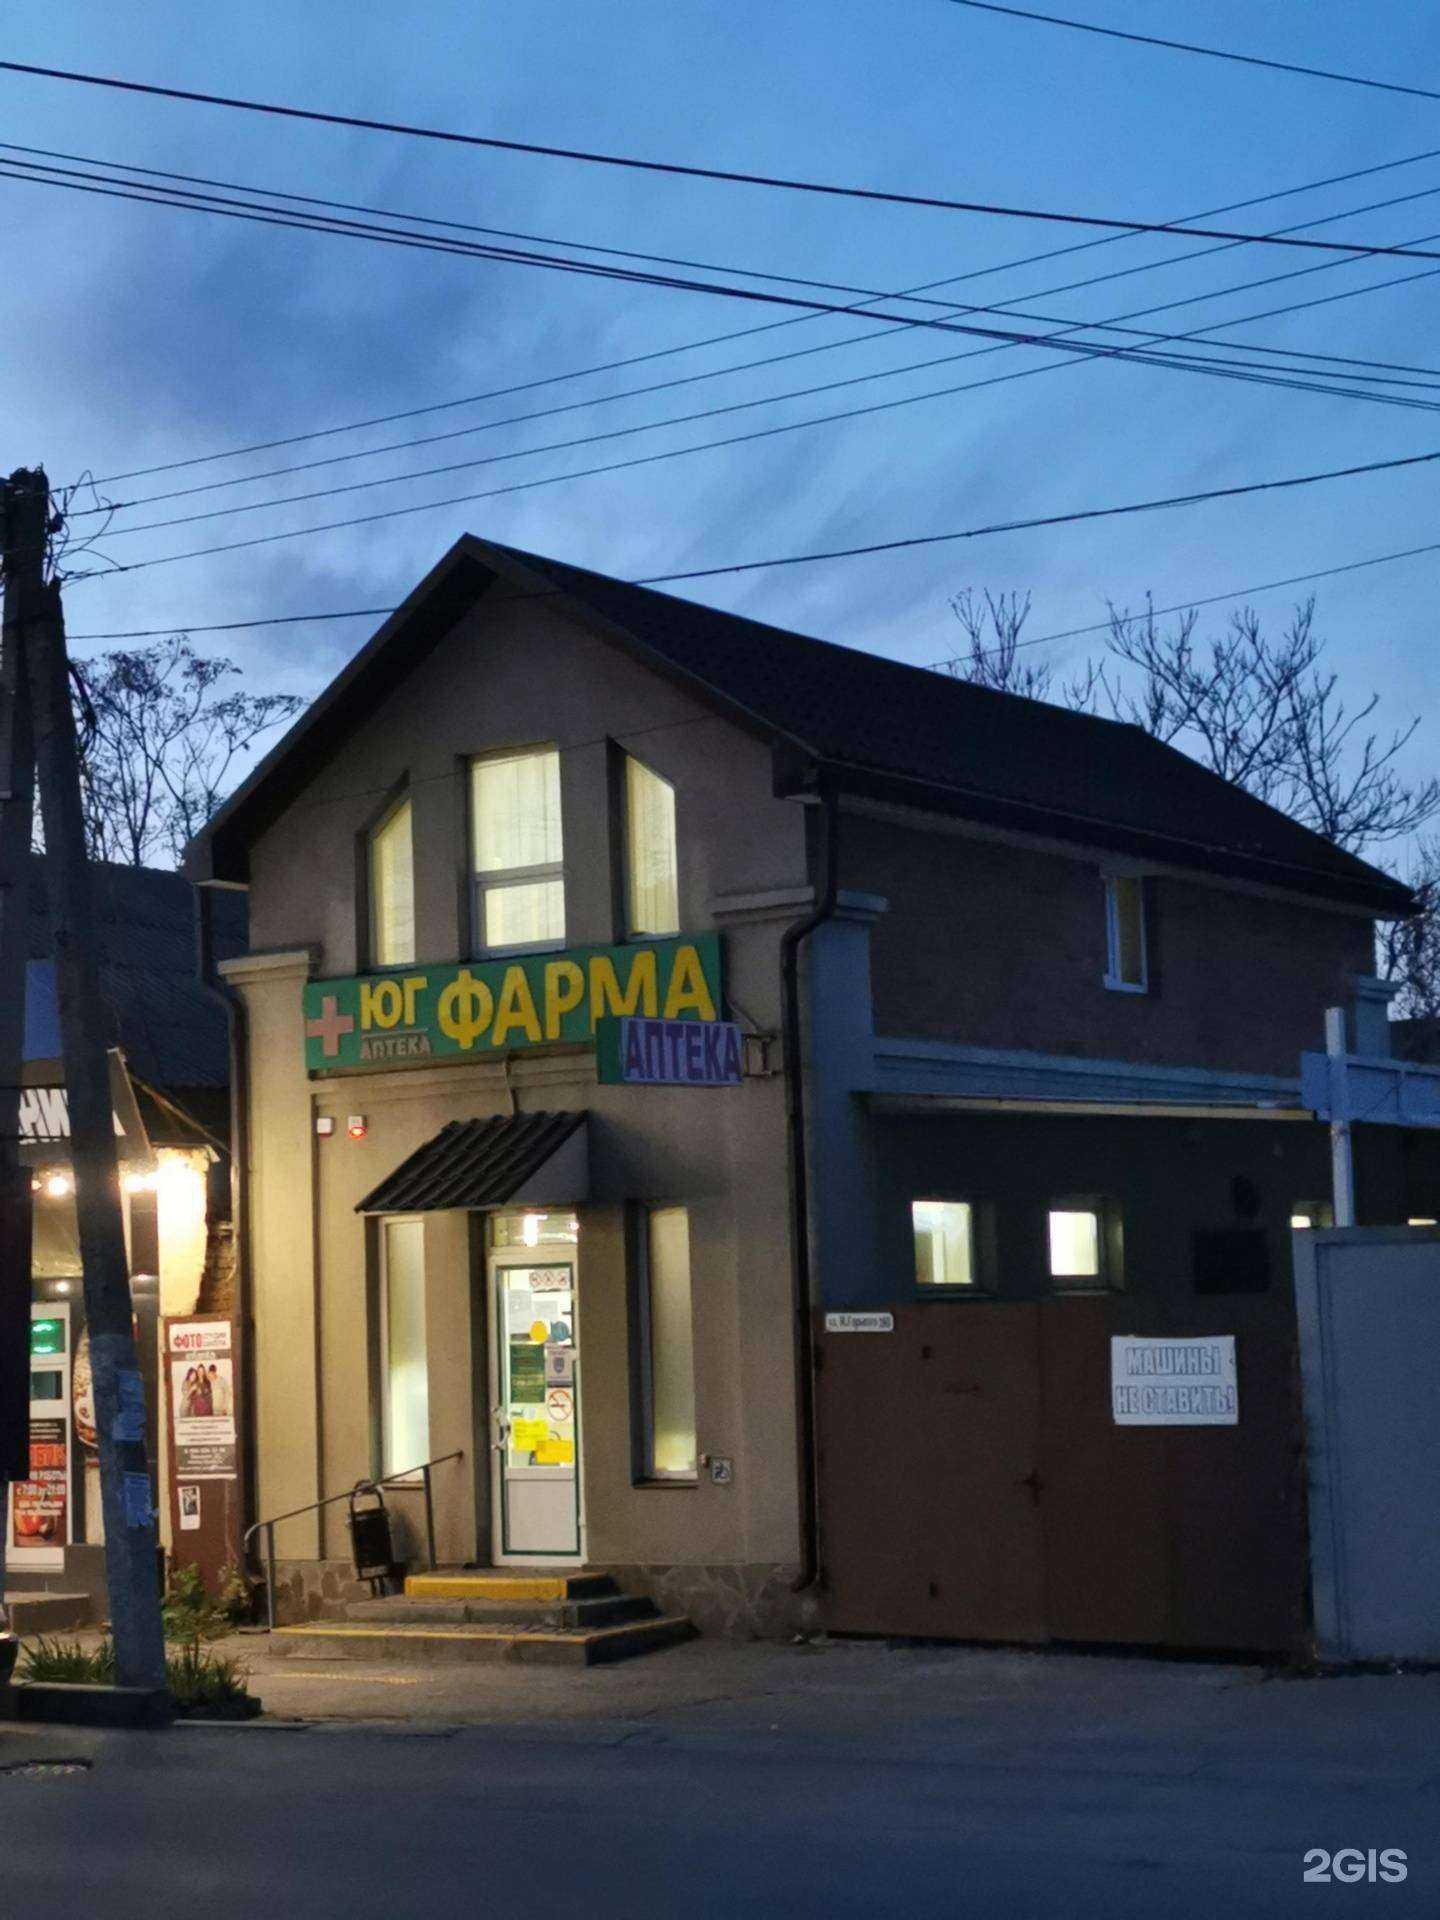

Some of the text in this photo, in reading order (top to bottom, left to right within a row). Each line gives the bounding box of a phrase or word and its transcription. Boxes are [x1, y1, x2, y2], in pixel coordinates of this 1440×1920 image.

[360, 946, 716, 1050] ЮГ ФАРМА
[361, 1034, 431, 1061] АПТЕКА
[626, 1020, 741, 1083] АПТЕКА
[173, 1333, 203, 1349] ФОТО
[1126, 1346, 1221, 1376] МАШИНЫ
[1115, 1385, 1235, 1415] НЕ СТАВИТЬ!
